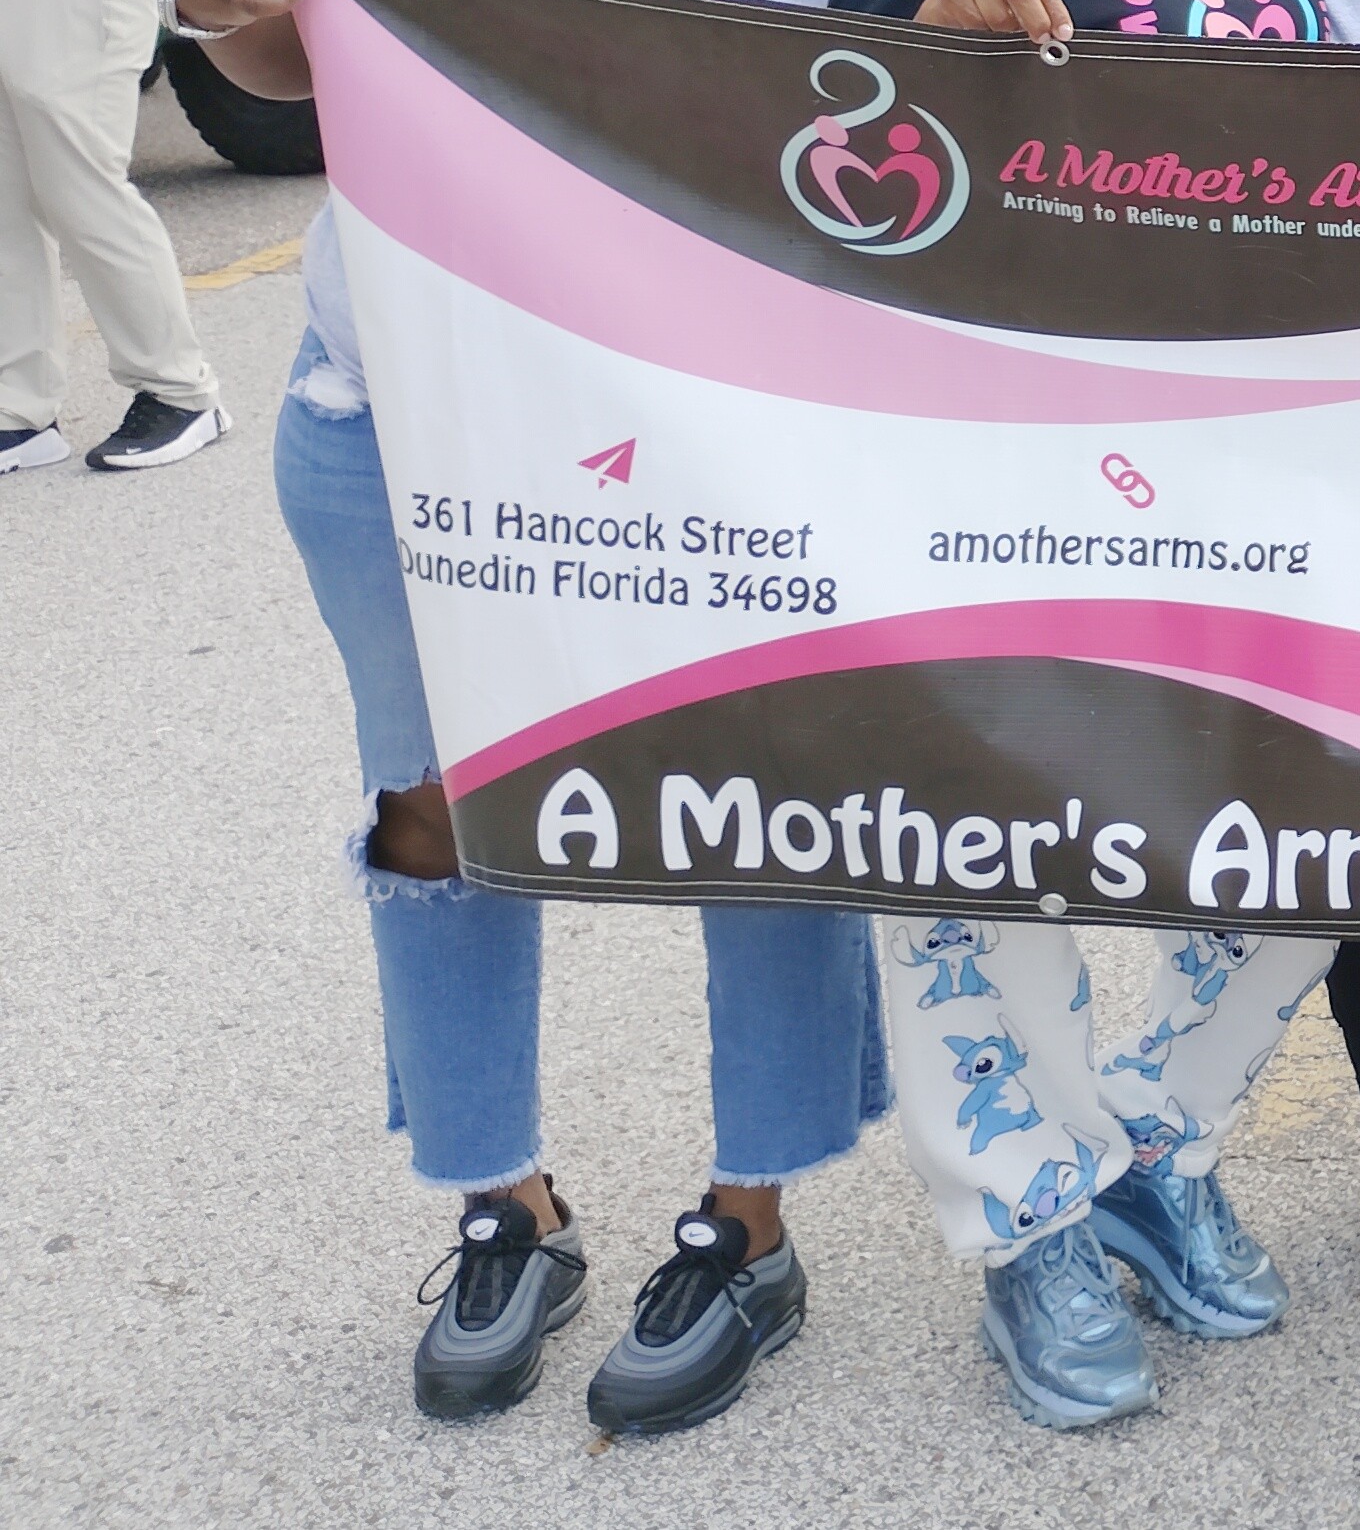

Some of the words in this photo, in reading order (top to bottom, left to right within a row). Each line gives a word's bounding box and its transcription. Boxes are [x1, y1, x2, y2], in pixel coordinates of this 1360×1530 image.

[1000, 139, 1049, 186] A
[1056, 145, 1296, 206] Mother's
[1003, 191, 1085, 224] Arriving
[1093, 202, 1117, 223] to
[1126, 205, 1199, 233] Relieve
[1208, 216, 1222, 234] a
[1232, 214, 1305, 238] Mother
[411, 493, 474, 537] 361
[495, 502, 666, 552] Hancock
[680, 515, 814, 561] Street
[928, 524, 1312, 576] amothersarms.org
[398, 535, 537, 596] Dunedin
[552, 560, 690, 607] Florida
[706, 572, 839, 617] 34698
[535, 766, 618, 869] A
[659, 773, 1149, 901] Mother's
